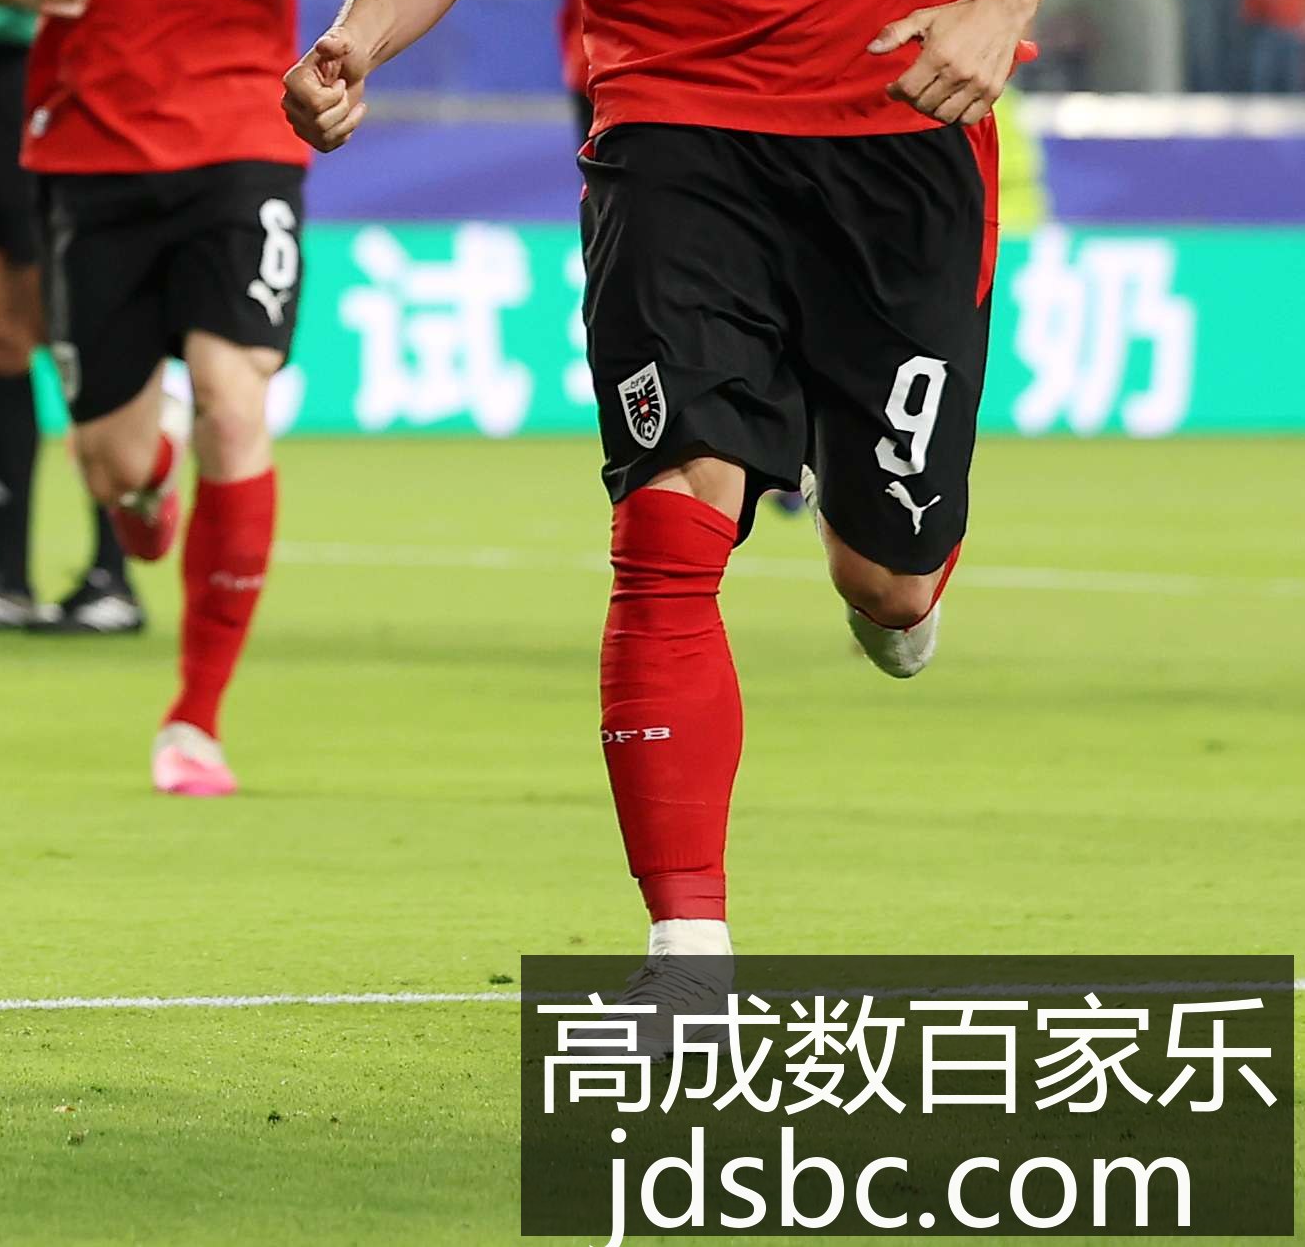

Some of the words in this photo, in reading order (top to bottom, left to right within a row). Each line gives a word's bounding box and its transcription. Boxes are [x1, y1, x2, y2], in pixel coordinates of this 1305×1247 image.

[259, 198, 299, 290] 6
[338, 223, 534, 438] 试
[1011, 225, 1197, 439] 奶
[875, 355, 950, 477] 9
